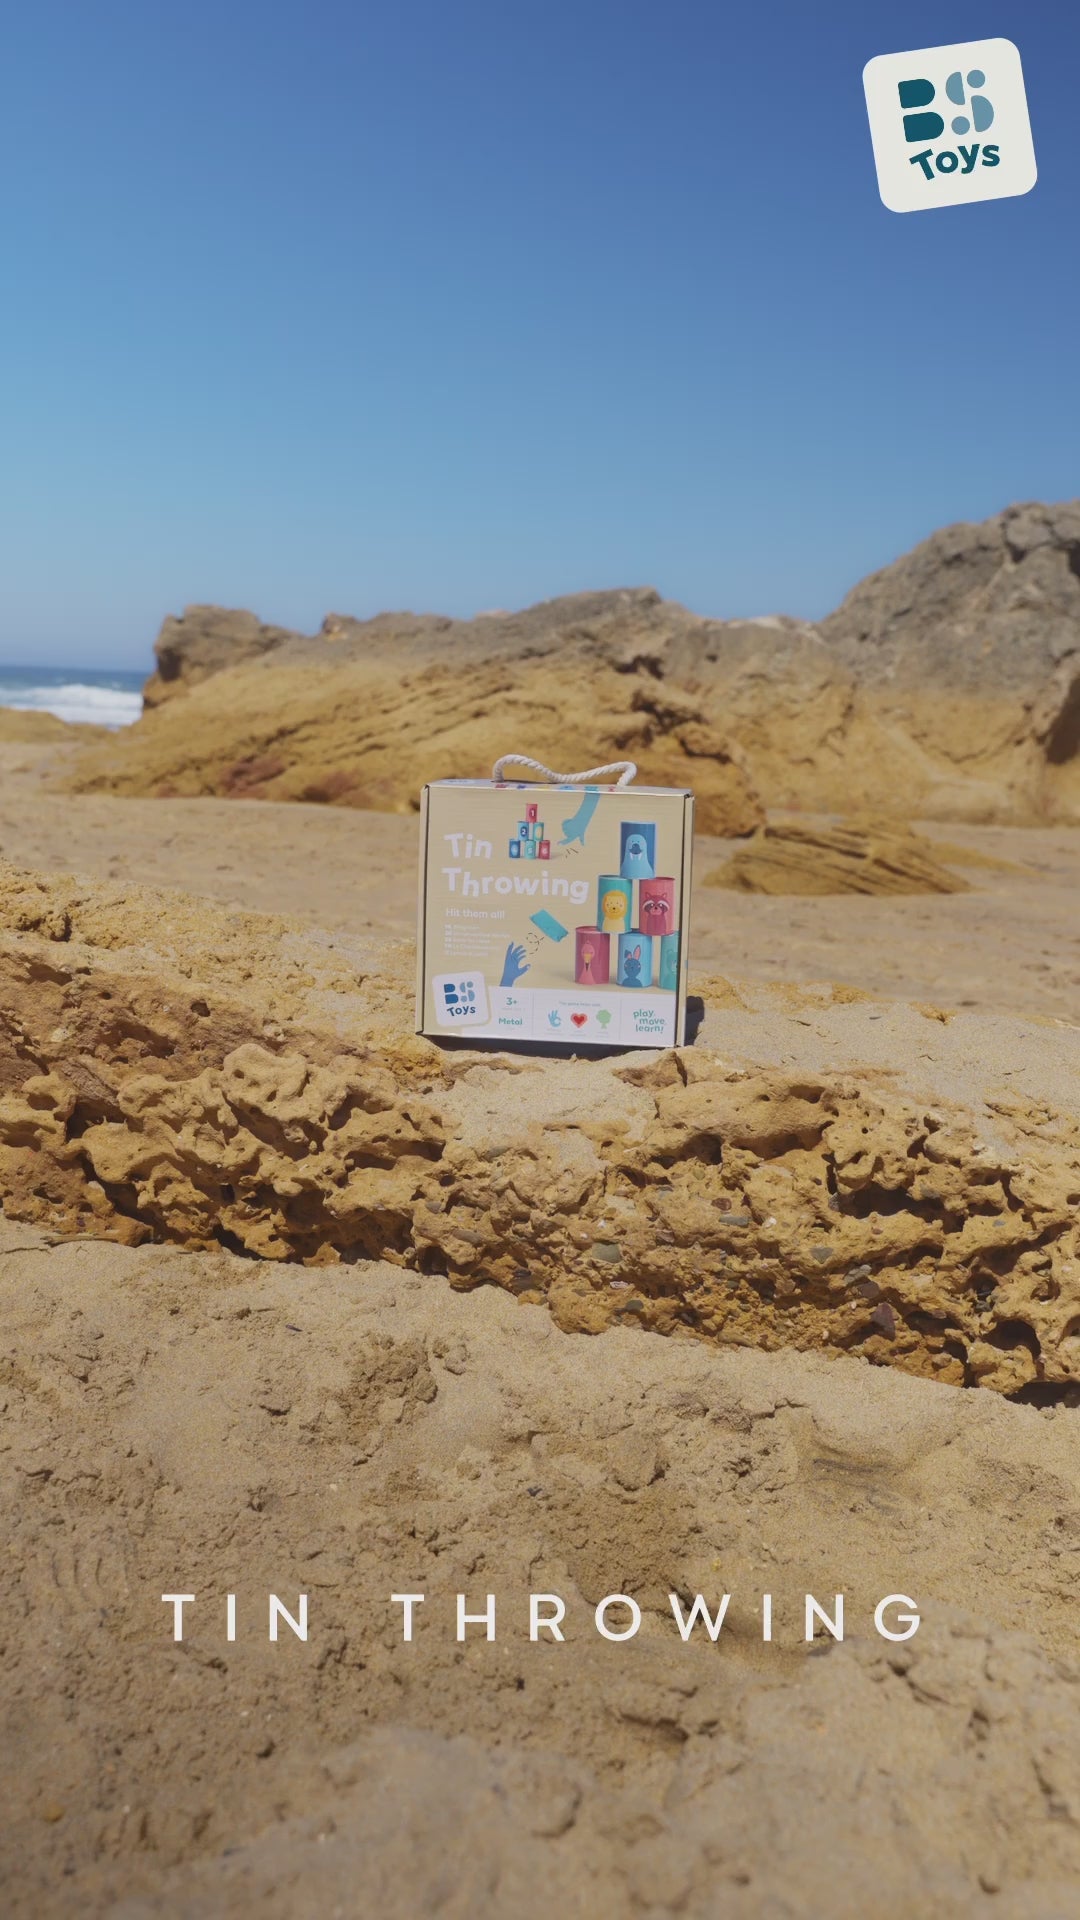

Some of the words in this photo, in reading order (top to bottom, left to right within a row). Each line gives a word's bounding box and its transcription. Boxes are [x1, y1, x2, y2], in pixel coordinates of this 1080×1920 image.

[443, 832, 493, 860] Tin
[441, 867, 590, 905] Throwing
[446, 907, 460, 917] Hit
[462, 907, 488, 919] them
[505, 996, 518, 1006] 3+
[446, 1005, 476, 1017] Toys
[498, 1017, 523, 1026] Metal
[635, 1023, 665, 1035] learn!
